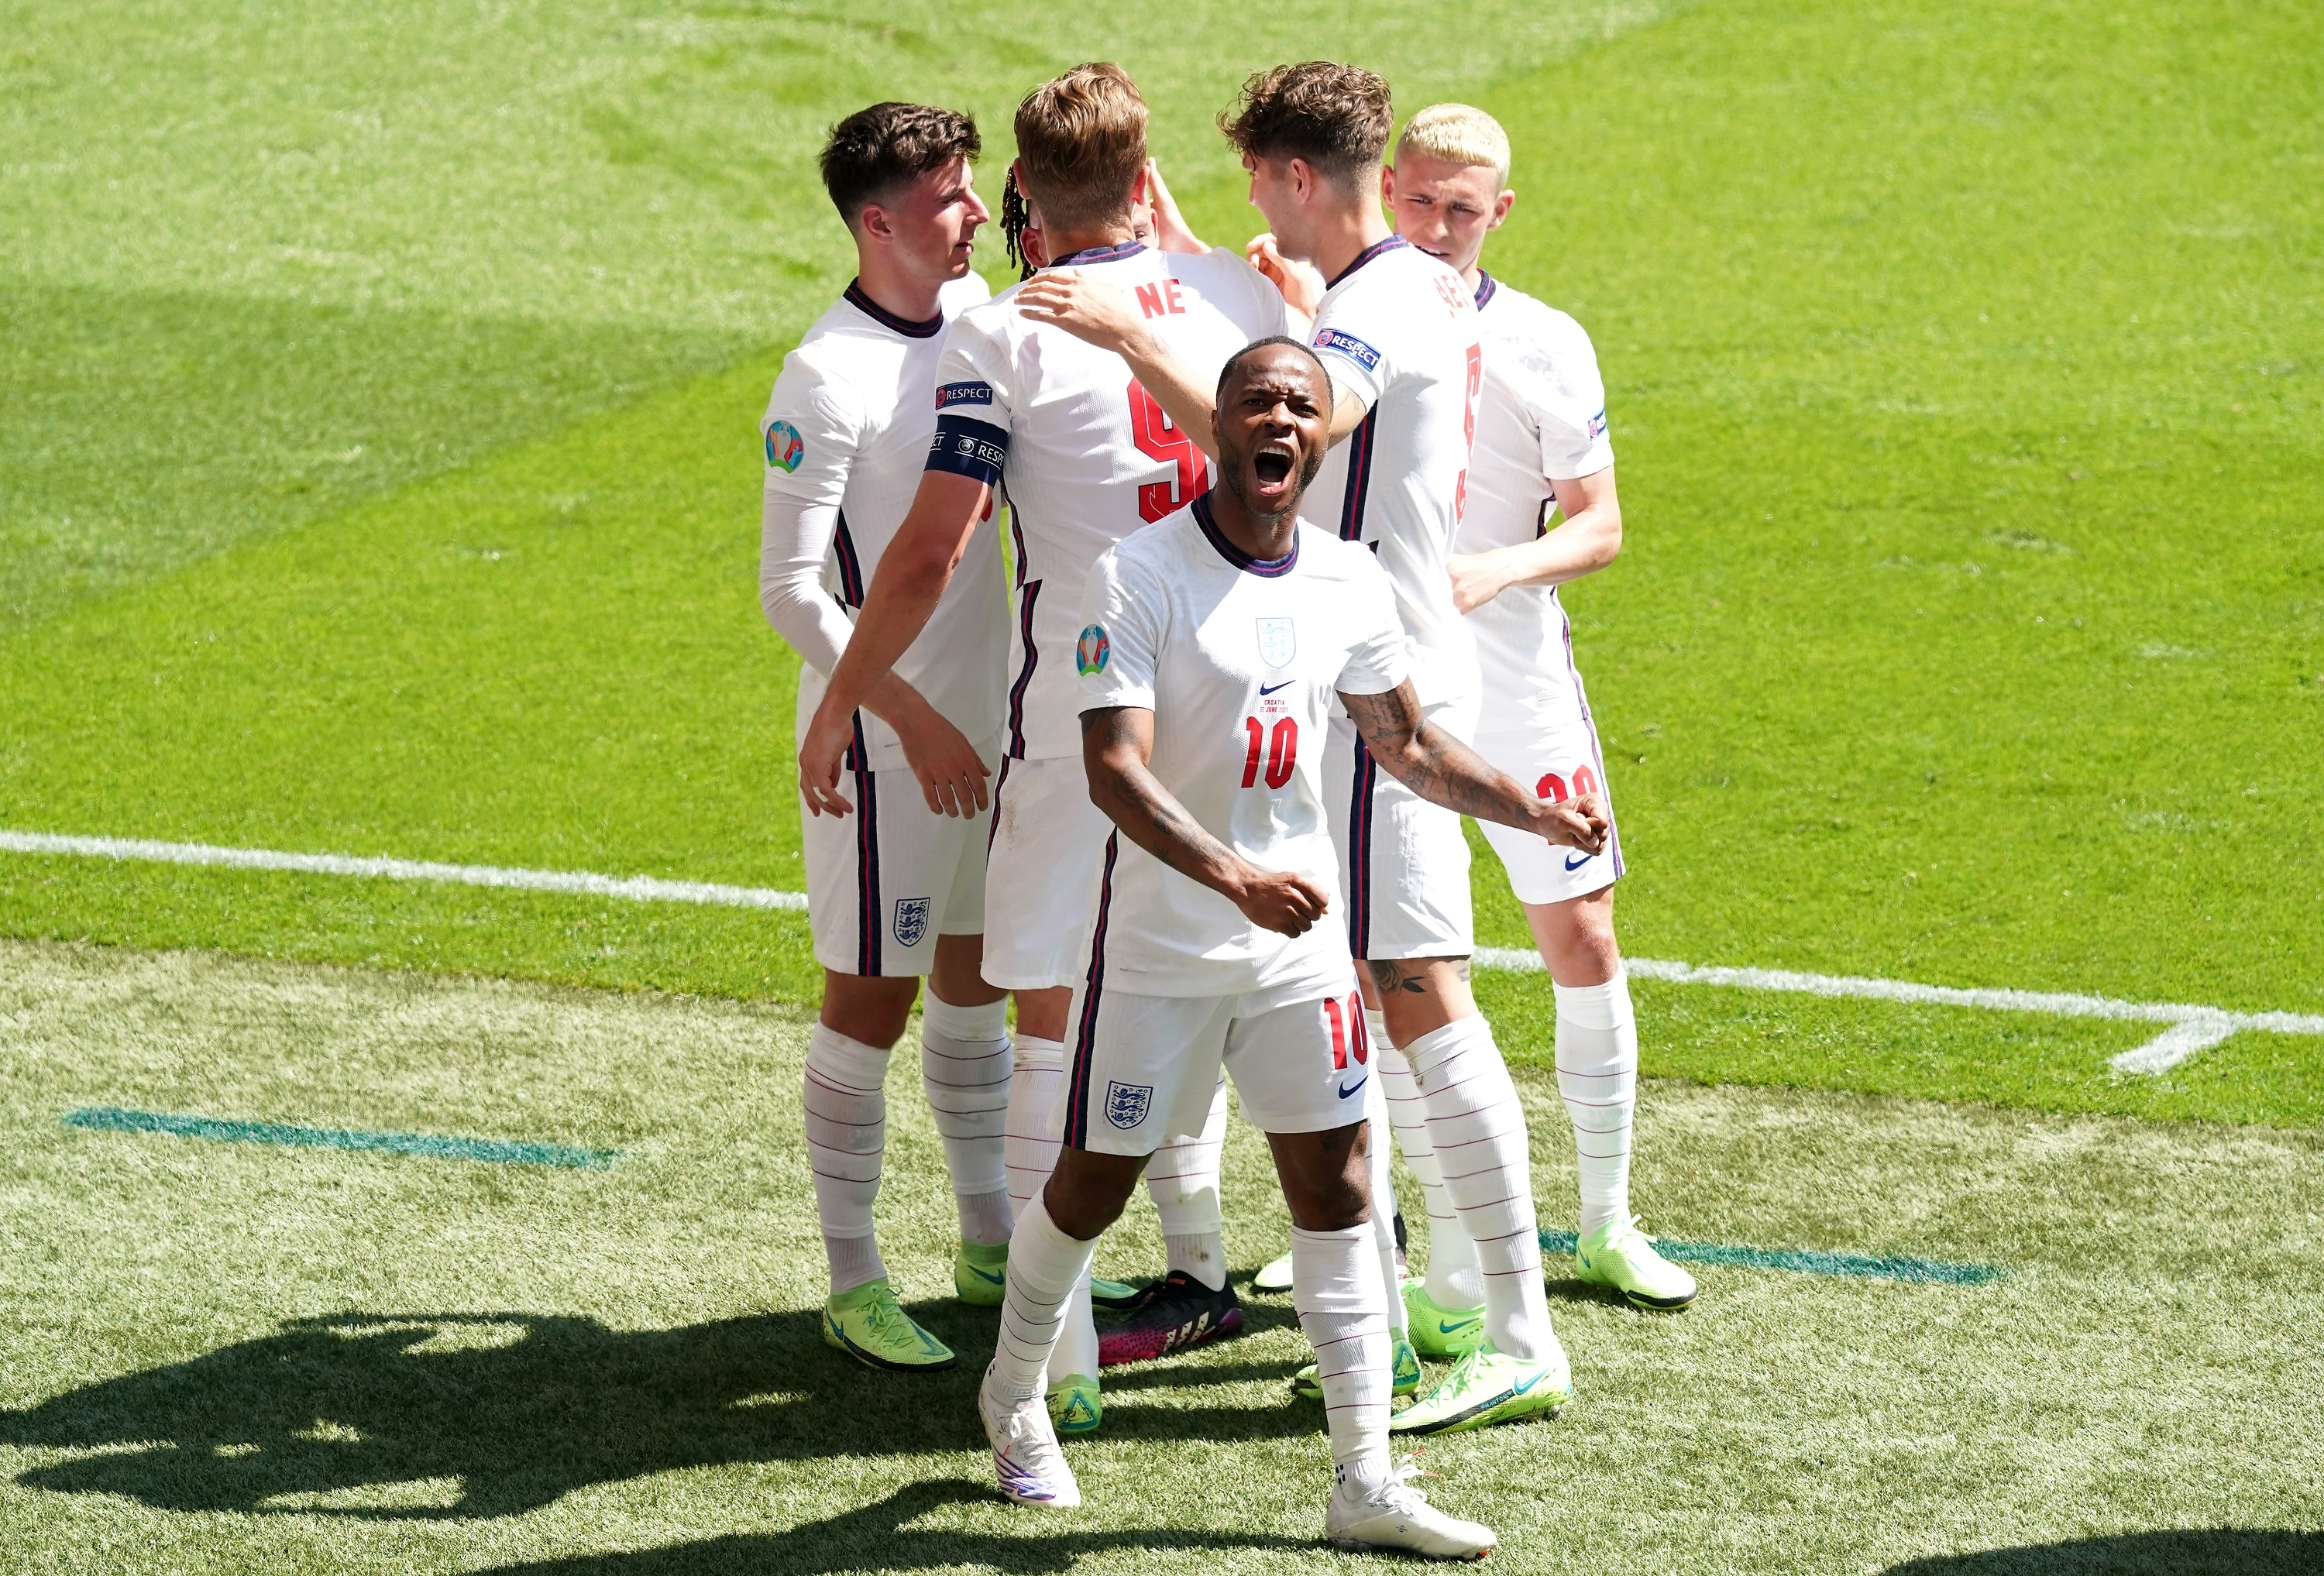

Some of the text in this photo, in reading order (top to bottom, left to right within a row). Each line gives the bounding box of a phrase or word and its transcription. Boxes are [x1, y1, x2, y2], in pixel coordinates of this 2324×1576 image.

[1134, 279, 1185, 319] NE
[1332, 335, 1379, 366] RESPECT
[946, 388, 992, 400] RESPECT
[978, 445, 1005, 466] RESP
[1127, 376, 1208, 524] 9
[1241, 716, 1298, 789] 10
[1324, 990, 1368, 1070] 10
